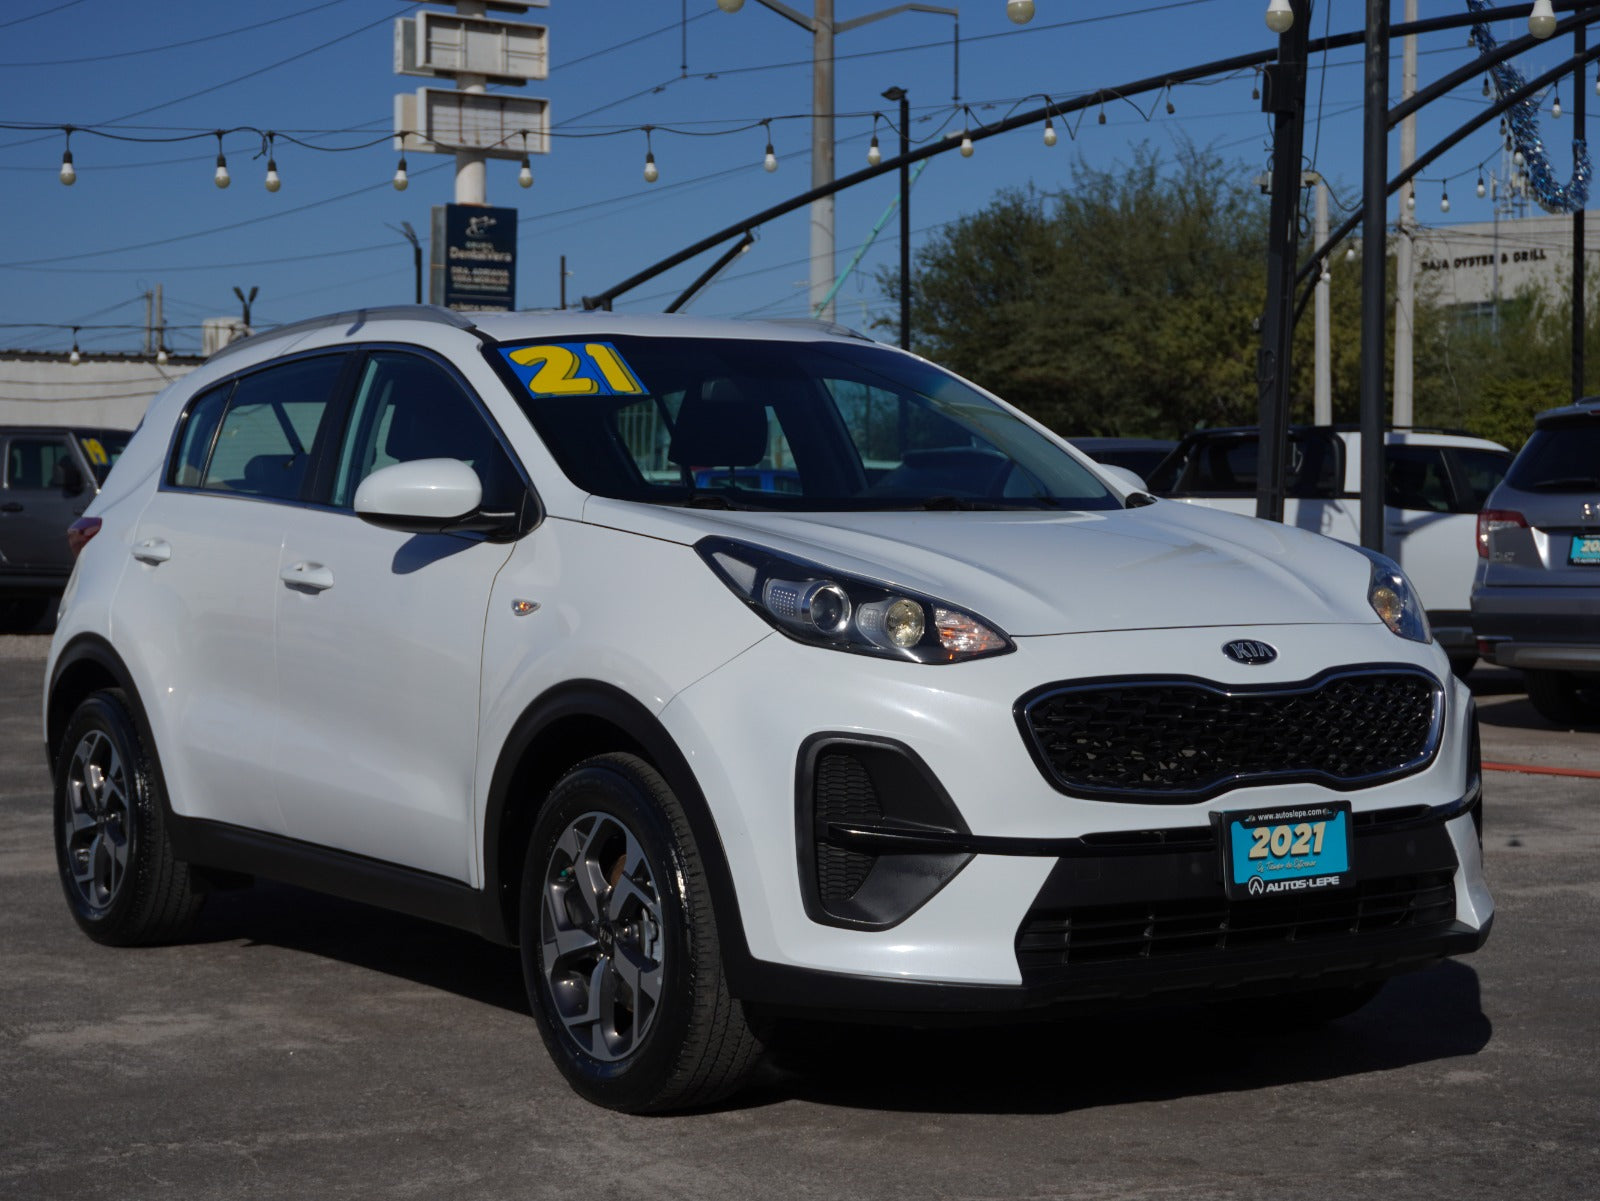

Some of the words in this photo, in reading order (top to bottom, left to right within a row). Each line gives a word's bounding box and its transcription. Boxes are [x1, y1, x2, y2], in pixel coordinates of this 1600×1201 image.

[1454, 255, 1494, 268] OYSTER
[1513, 248, 1546, 263] GRILL
[509, 343, 643, 395] 21
[1229, 642, 1273, 659] KIA
[1257, 809, 1322, 821] www.autoslepe.com
[1248, 821, 1327, 860] 2021
